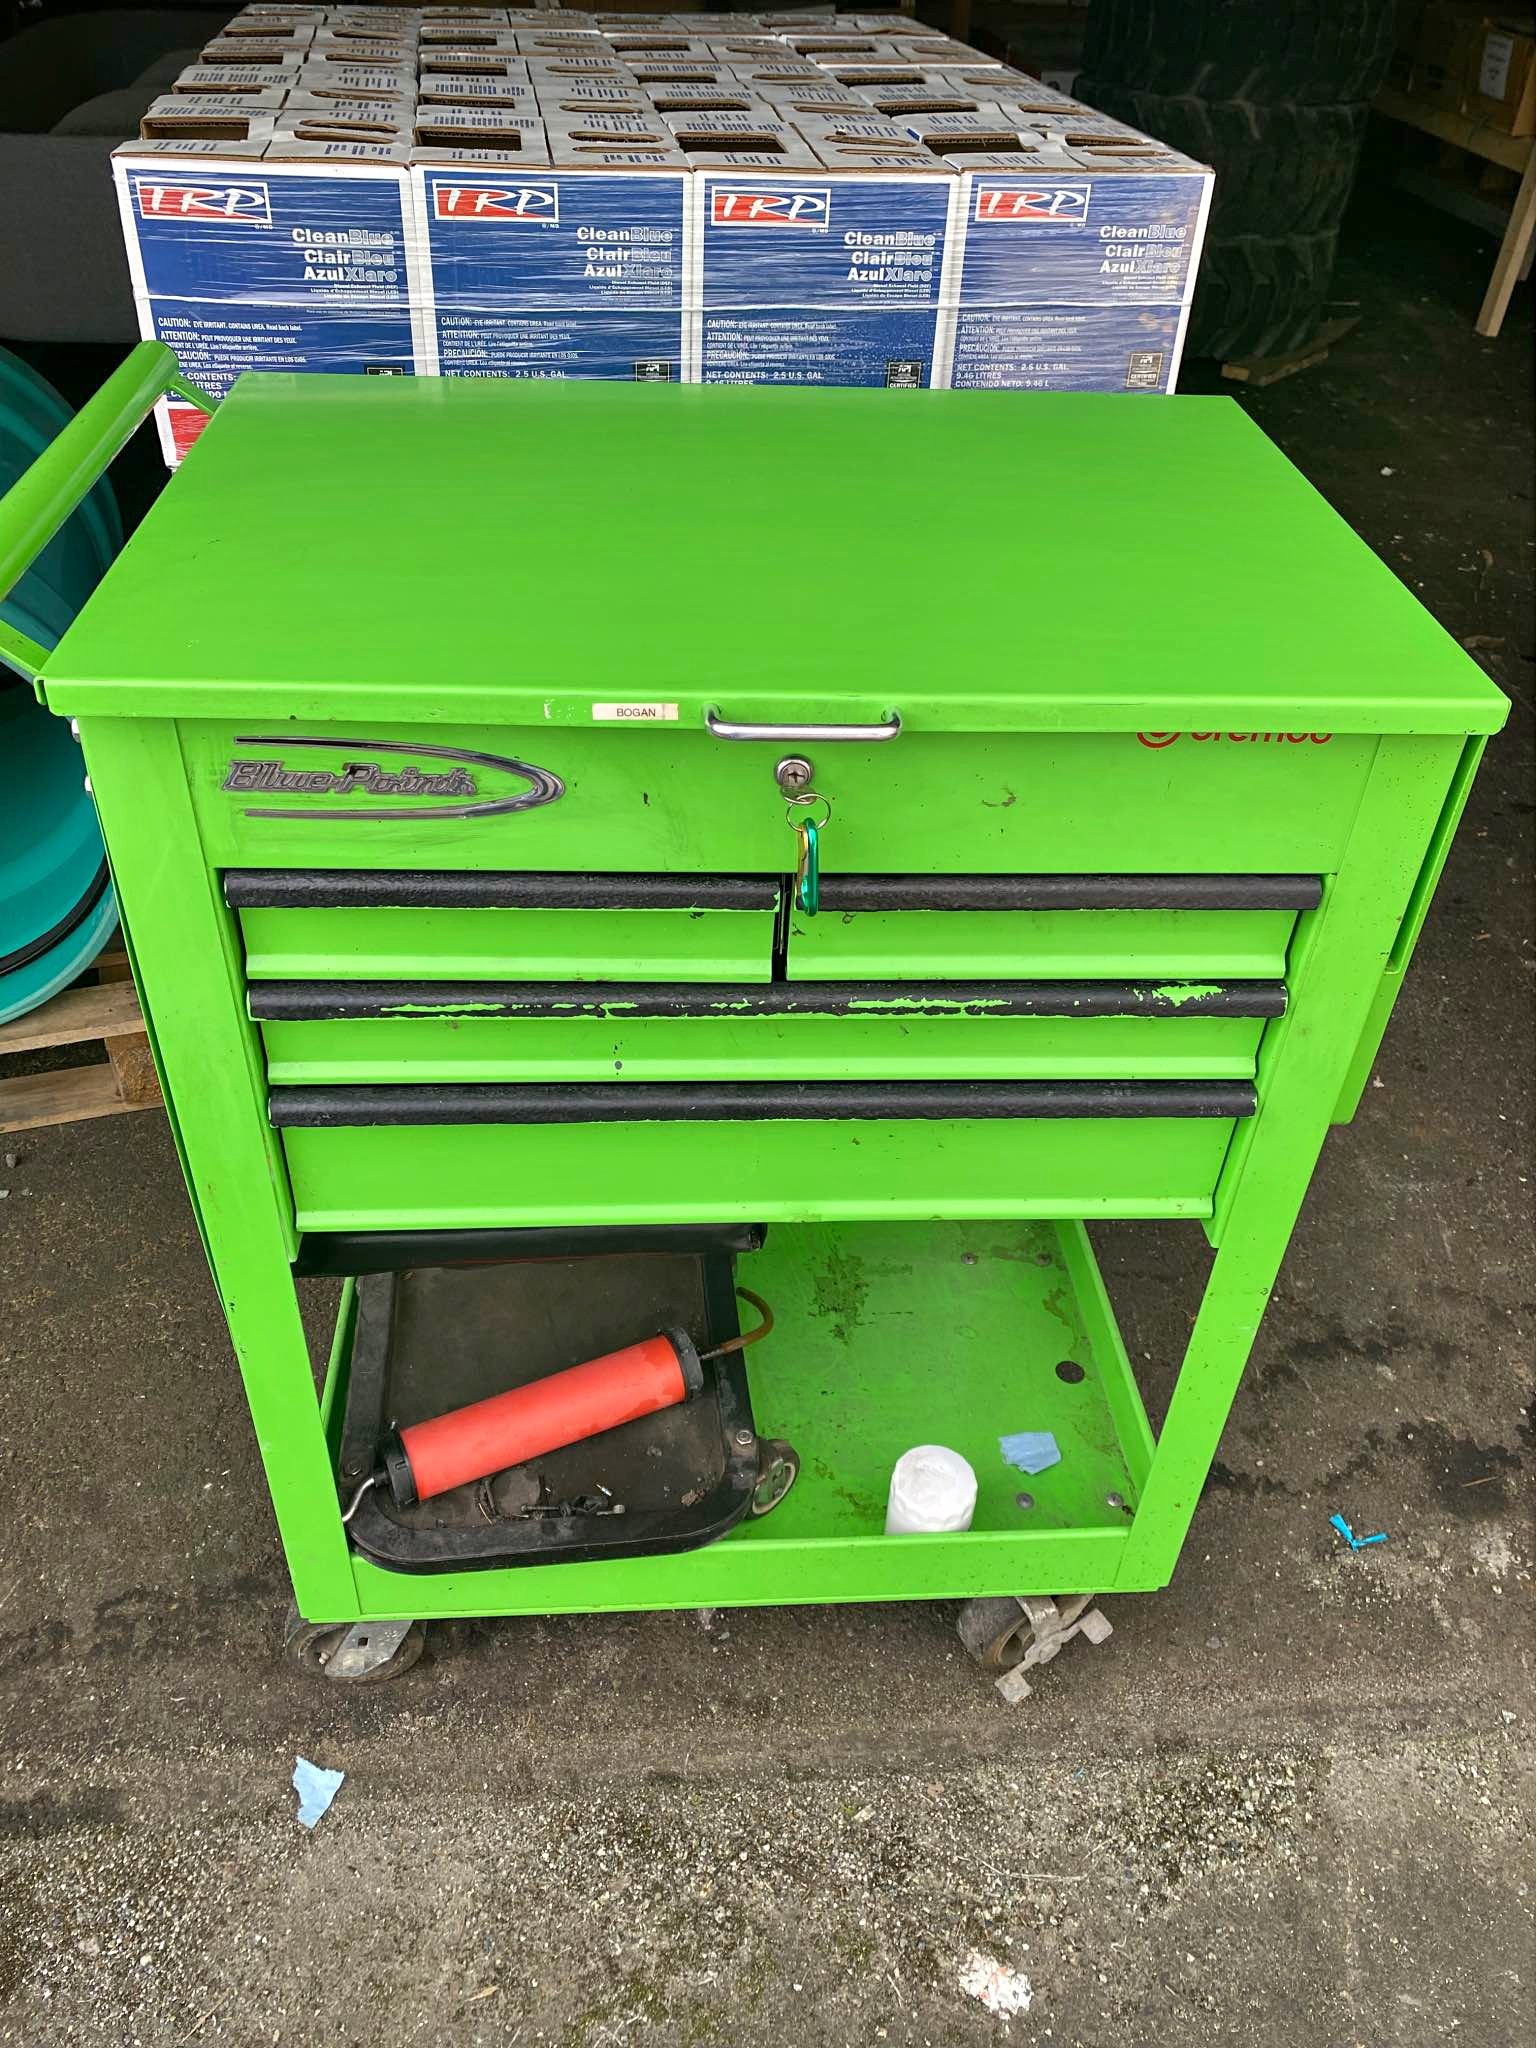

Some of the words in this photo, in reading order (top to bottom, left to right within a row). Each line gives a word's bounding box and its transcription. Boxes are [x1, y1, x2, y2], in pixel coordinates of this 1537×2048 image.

[139, 186, 265, 216] TRP
[436, 187, 554, 215] TRP
[715, 193, 826, 221] TRP
[980, 190, 1086, 215] TRP
[292, 228, 394, 246] CleanBlue
[577, 226, 673, 243] CleanBlue
[844, 231, 936, 247] CleanBlue
[304, 249, 395, 266] ClairBleu
[586, 247, 672, 262] ClairBleu
[851, 251, 933, 266] ClairBleu
[303, 266, 398, 282] AzulXlaro
[583, 264, 673, 279] AzulXlaro
[847, 267, 933, 281] AzulXlaro
[158, 317, 191, 328] CAUTION:
[441, 317, 472, 326] CAUTION:
[160, 330, 200, 341] ATTENTION:
[442, 330, 480, 339] ATTENTION:
[707, 332, 743, 341] ATTENTION:
[177, 349, 211, 361] CAUCIÓN:
[187, 372, 237, 381] CONTENTS:
[444, 370, 461, 378] NET
[463, 370, 510, 378] CONTENTS:
[706, 371, 721, 379] NET
[723, 371, 769, 379] CONTENTS:
[806, 371, 824, 379] GAL.
[192, 381, 222, 389] ITRES
[955, 379, 1000, 387] CONTENIDO
[616, 708, 656, 717] BOGAN
